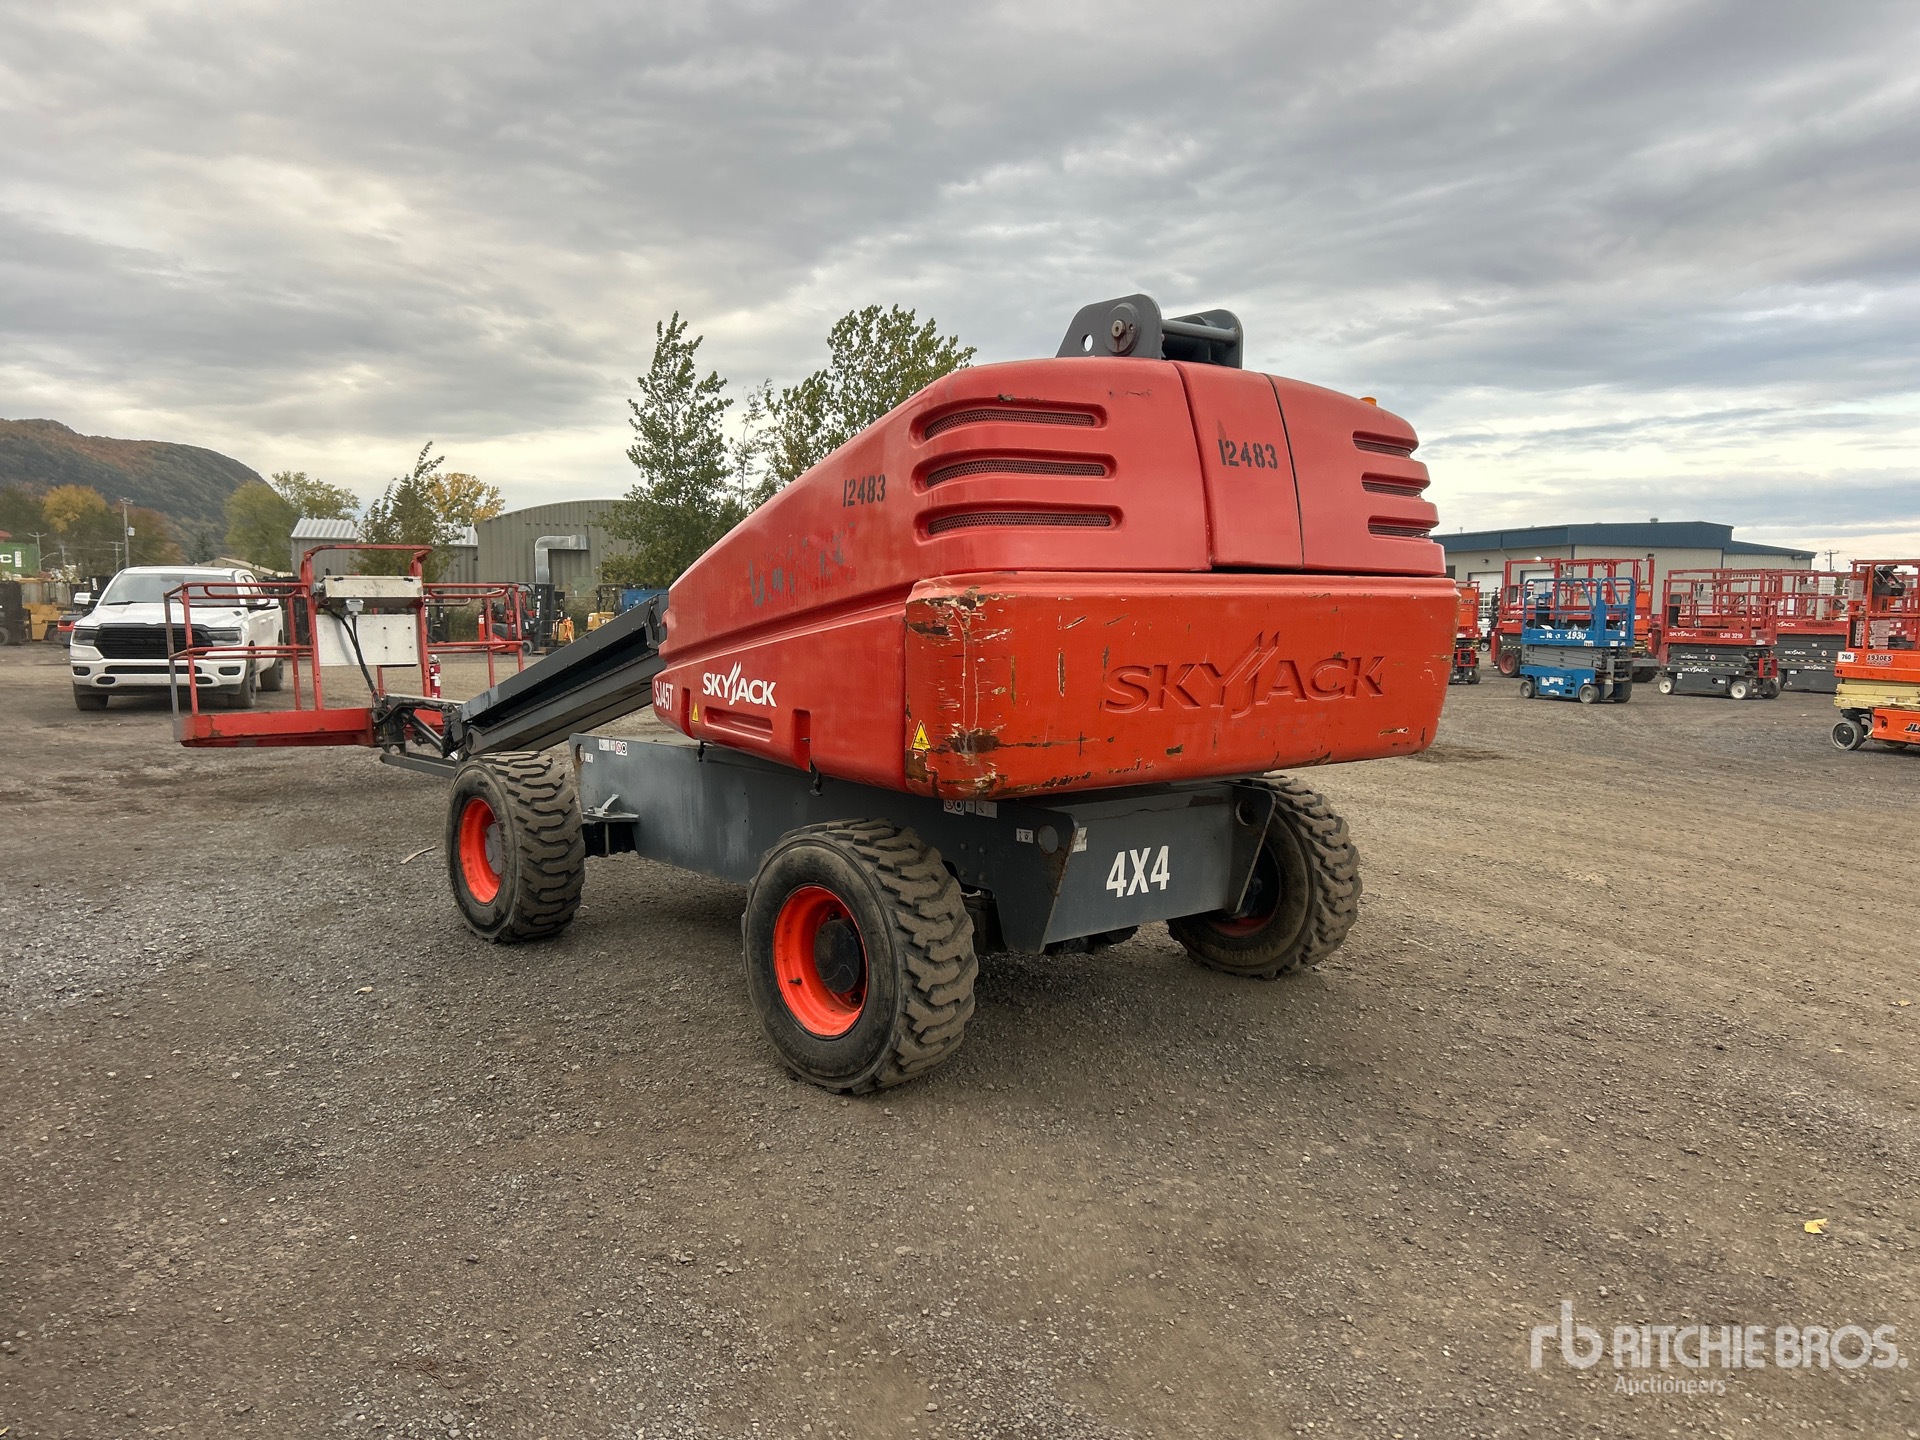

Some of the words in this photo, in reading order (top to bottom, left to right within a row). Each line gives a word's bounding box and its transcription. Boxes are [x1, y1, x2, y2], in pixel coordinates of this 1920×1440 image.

[1217, 438, 1278, 470] 12483
[842, 474, 886, 507] 12483
[1681, 665, 1710, 673] SKYJACK
[1867, 654, 1893, 662] 1930ES
[702, 661, 778, 708] SKYJACK
[1104, 631, 1385, 719] SKYJACK
[654, 680, 674, 711] SJ45T
[1106, 845, 1171, 898] 4X4
